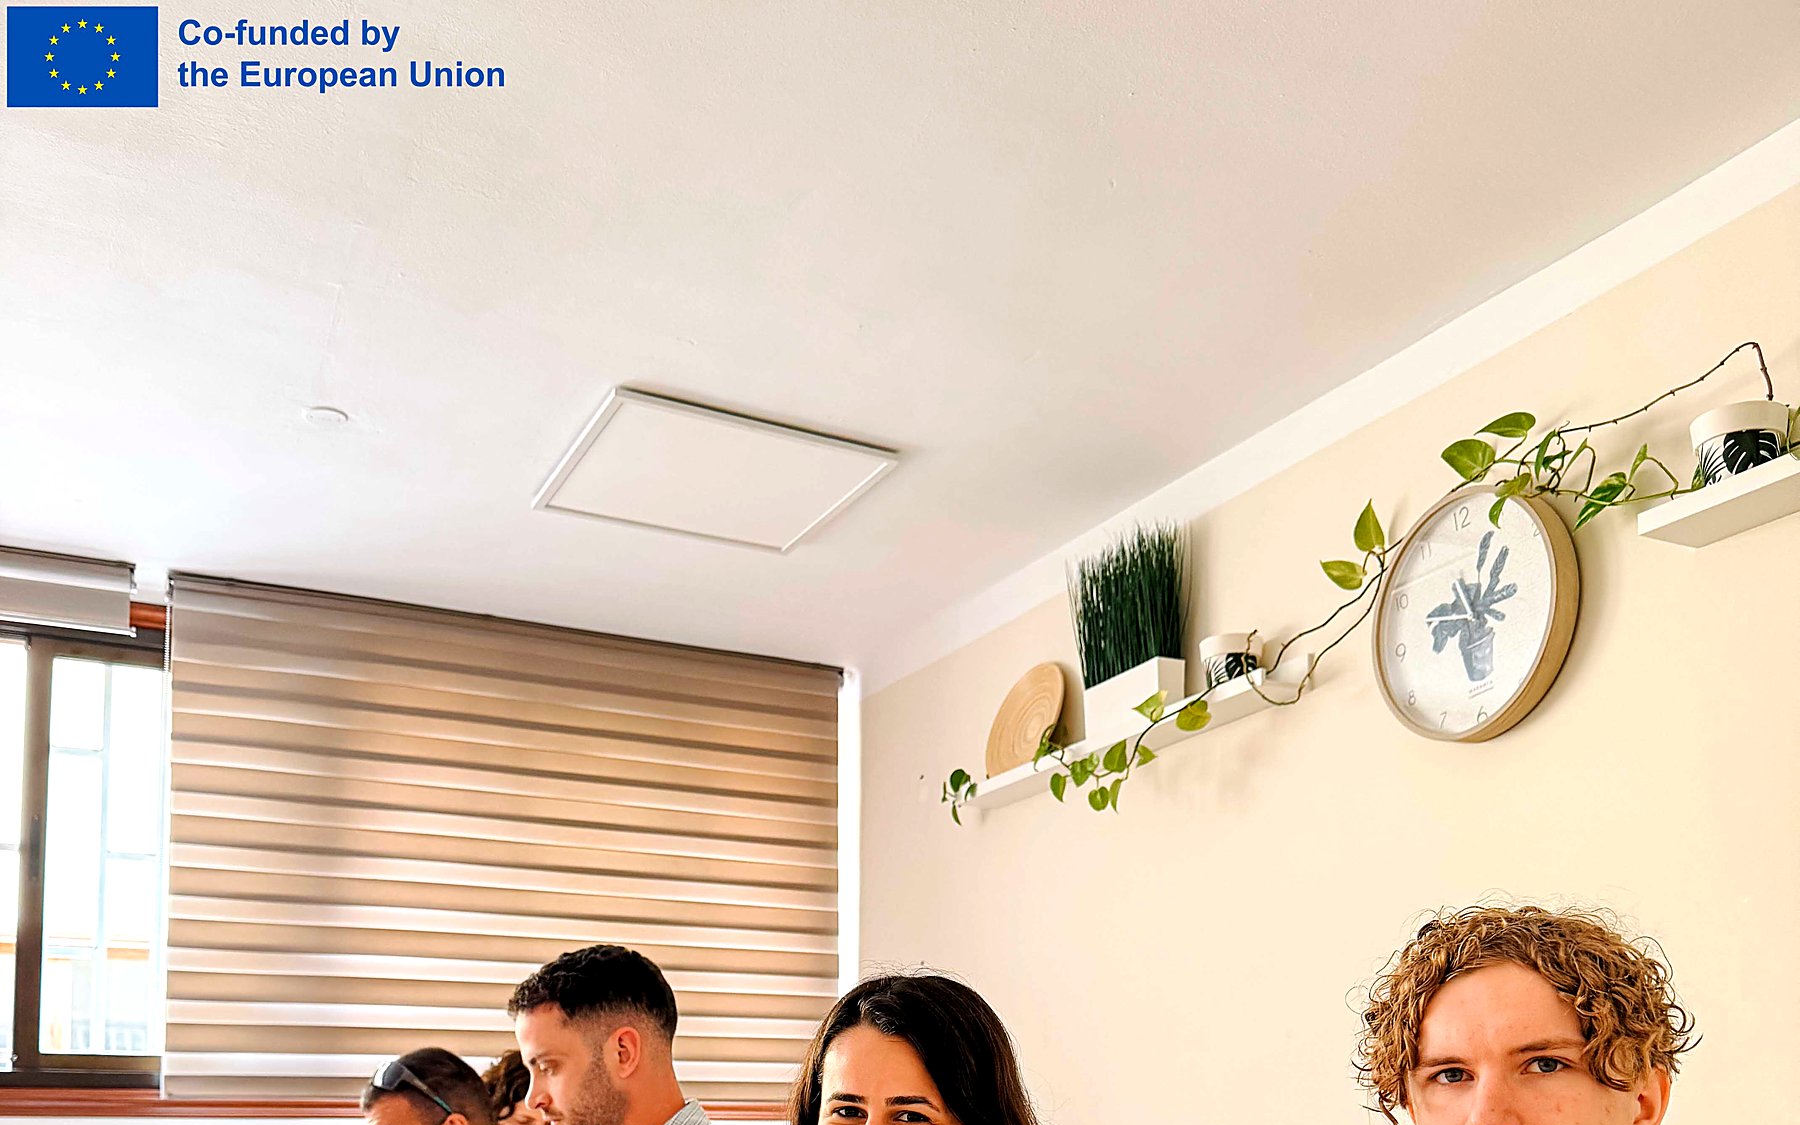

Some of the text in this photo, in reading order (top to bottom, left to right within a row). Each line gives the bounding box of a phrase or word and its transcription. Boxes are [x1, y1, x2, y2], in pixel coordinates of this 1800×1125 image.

[1453, 506, 1471, 531] 12
[1419, 545, 1432, 560] 11
[1395, 593, 1409, 610] 10
[1395, 643, 1407, 663] 9
[1408, 691, 1417, 706] 8
[1439, 711, 1448, 729] 7
[1476, 705, 1489, 725] 6
